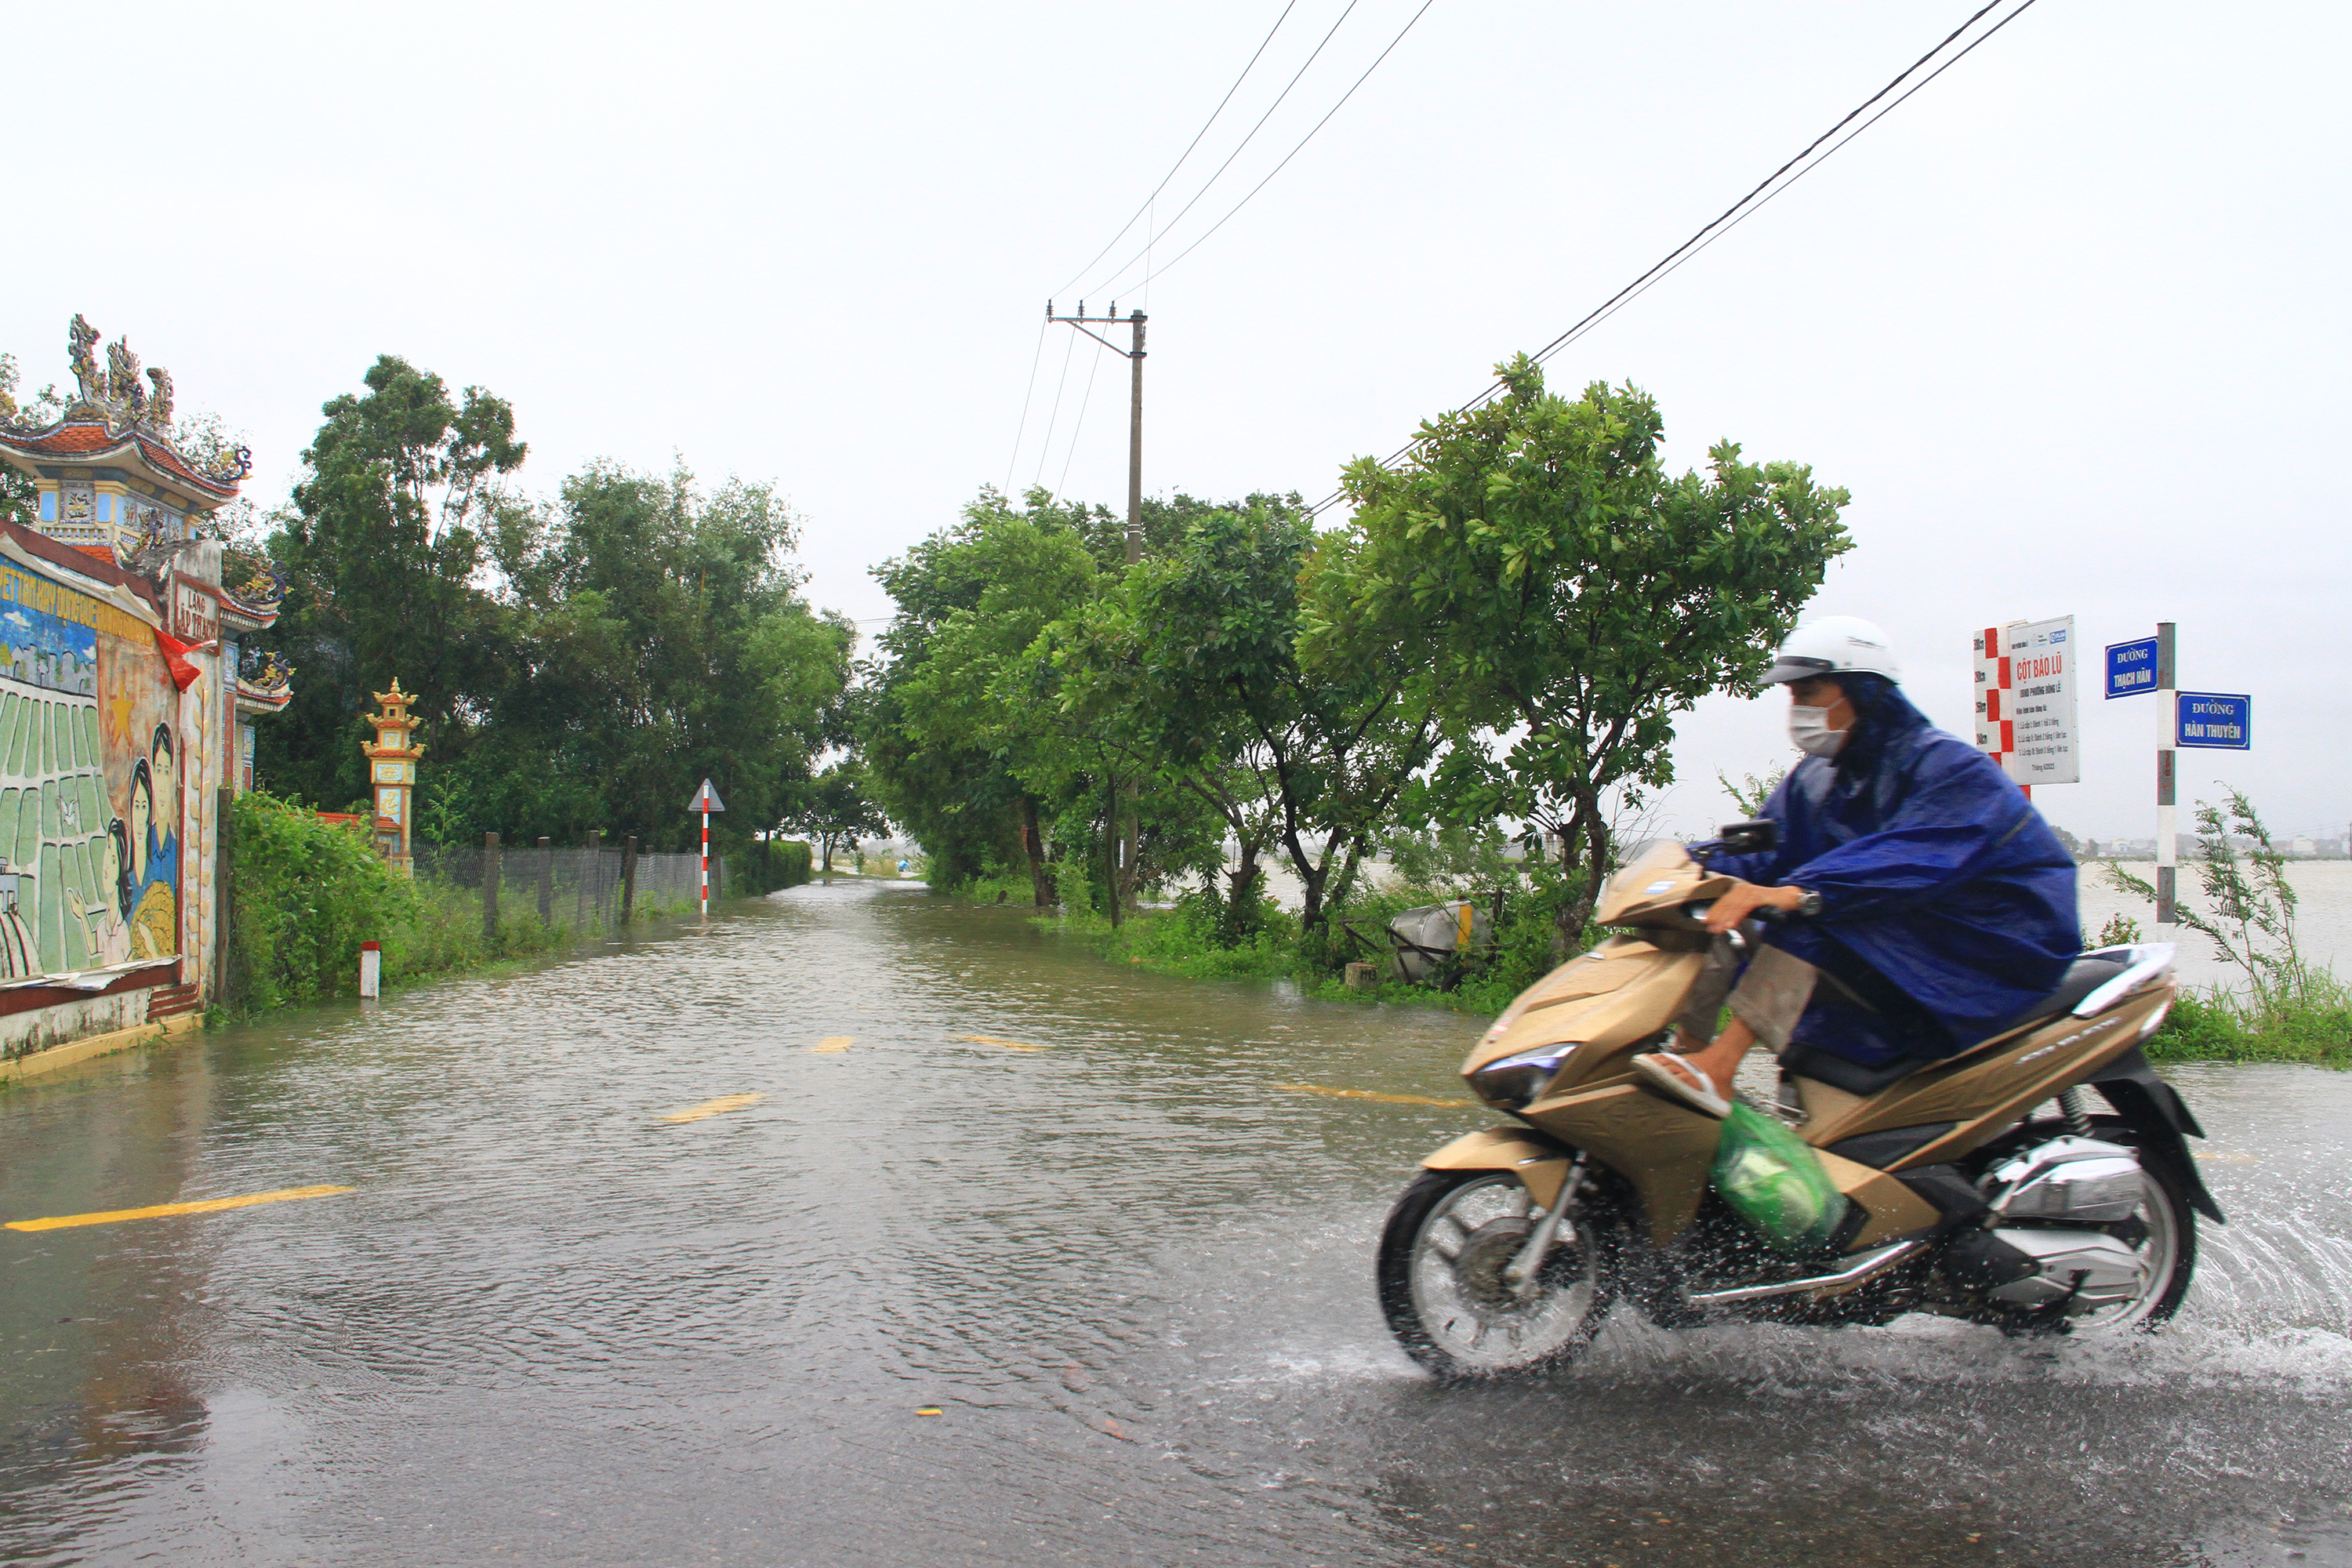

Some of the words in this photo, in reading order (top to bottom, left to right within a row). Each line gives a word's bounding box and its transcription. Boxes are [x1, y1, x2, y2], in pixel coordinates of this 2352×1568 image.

[2117, 648, 2148, 664] ĐƯỜNG
[2017, 657, 2031, 684] CỘT
[2034, 654, 2049, 677] BÁO
[2052, 652, 2061, 674] LŨ
[2114, 672, 2136, 689] THẠCH
[2136, 667, 2151, 684] HÀN
[2192, 699, 2234, 715] ĐƯỜNG
[2185, 720, 2204, 737] HÀN
[2205, 722, 2241, 739] THUYÊN
